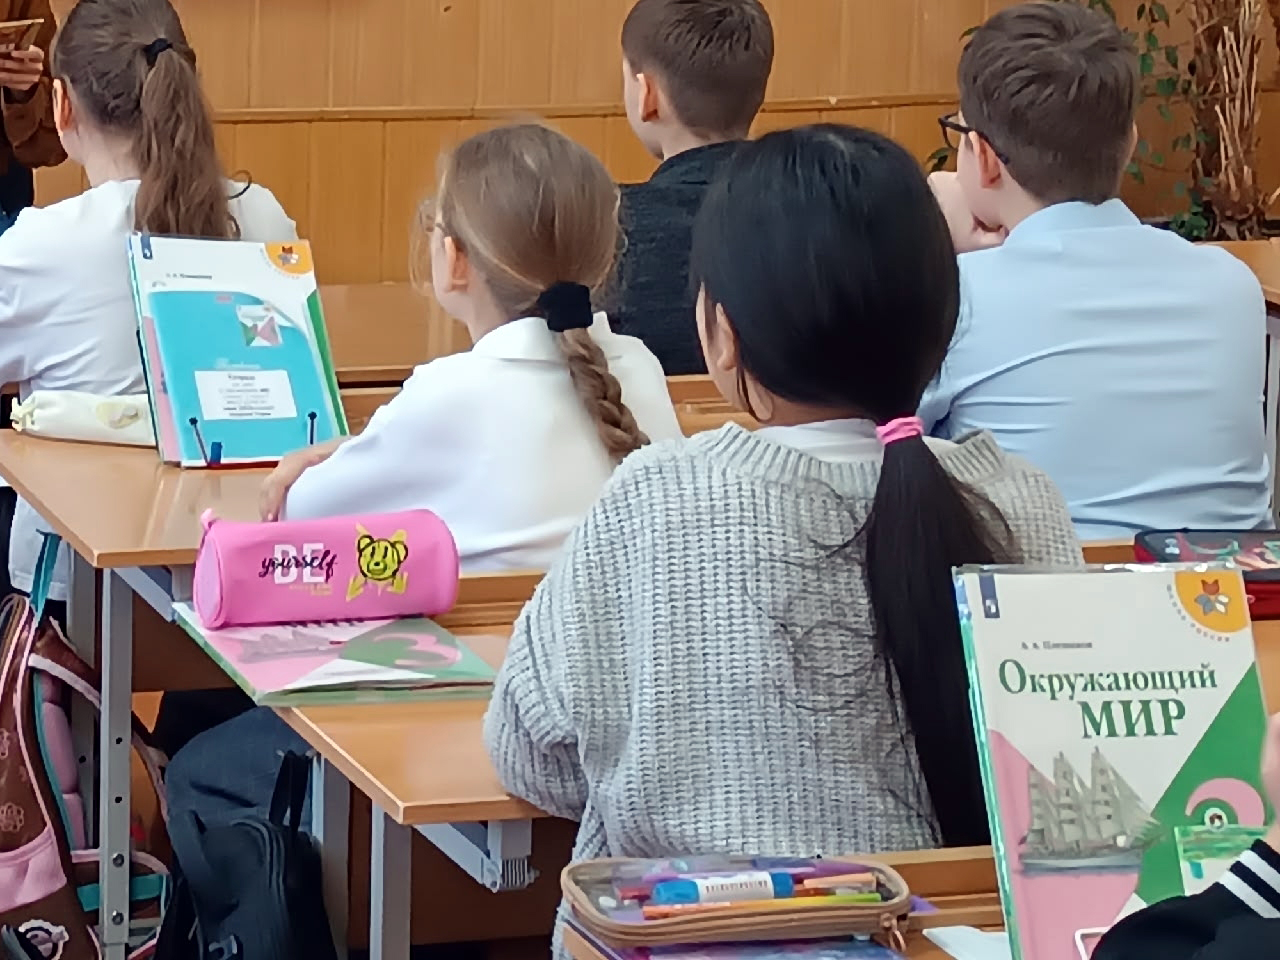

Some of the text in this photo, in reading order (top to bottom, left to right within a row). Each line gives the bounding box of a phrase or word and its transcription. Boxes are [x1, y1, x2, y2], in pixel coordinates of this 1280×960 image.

[258, 549, 338, 584] yourself
[998, 657, 1219, 701] Окружающий
[1076, 697, 1187, 739] МИР
